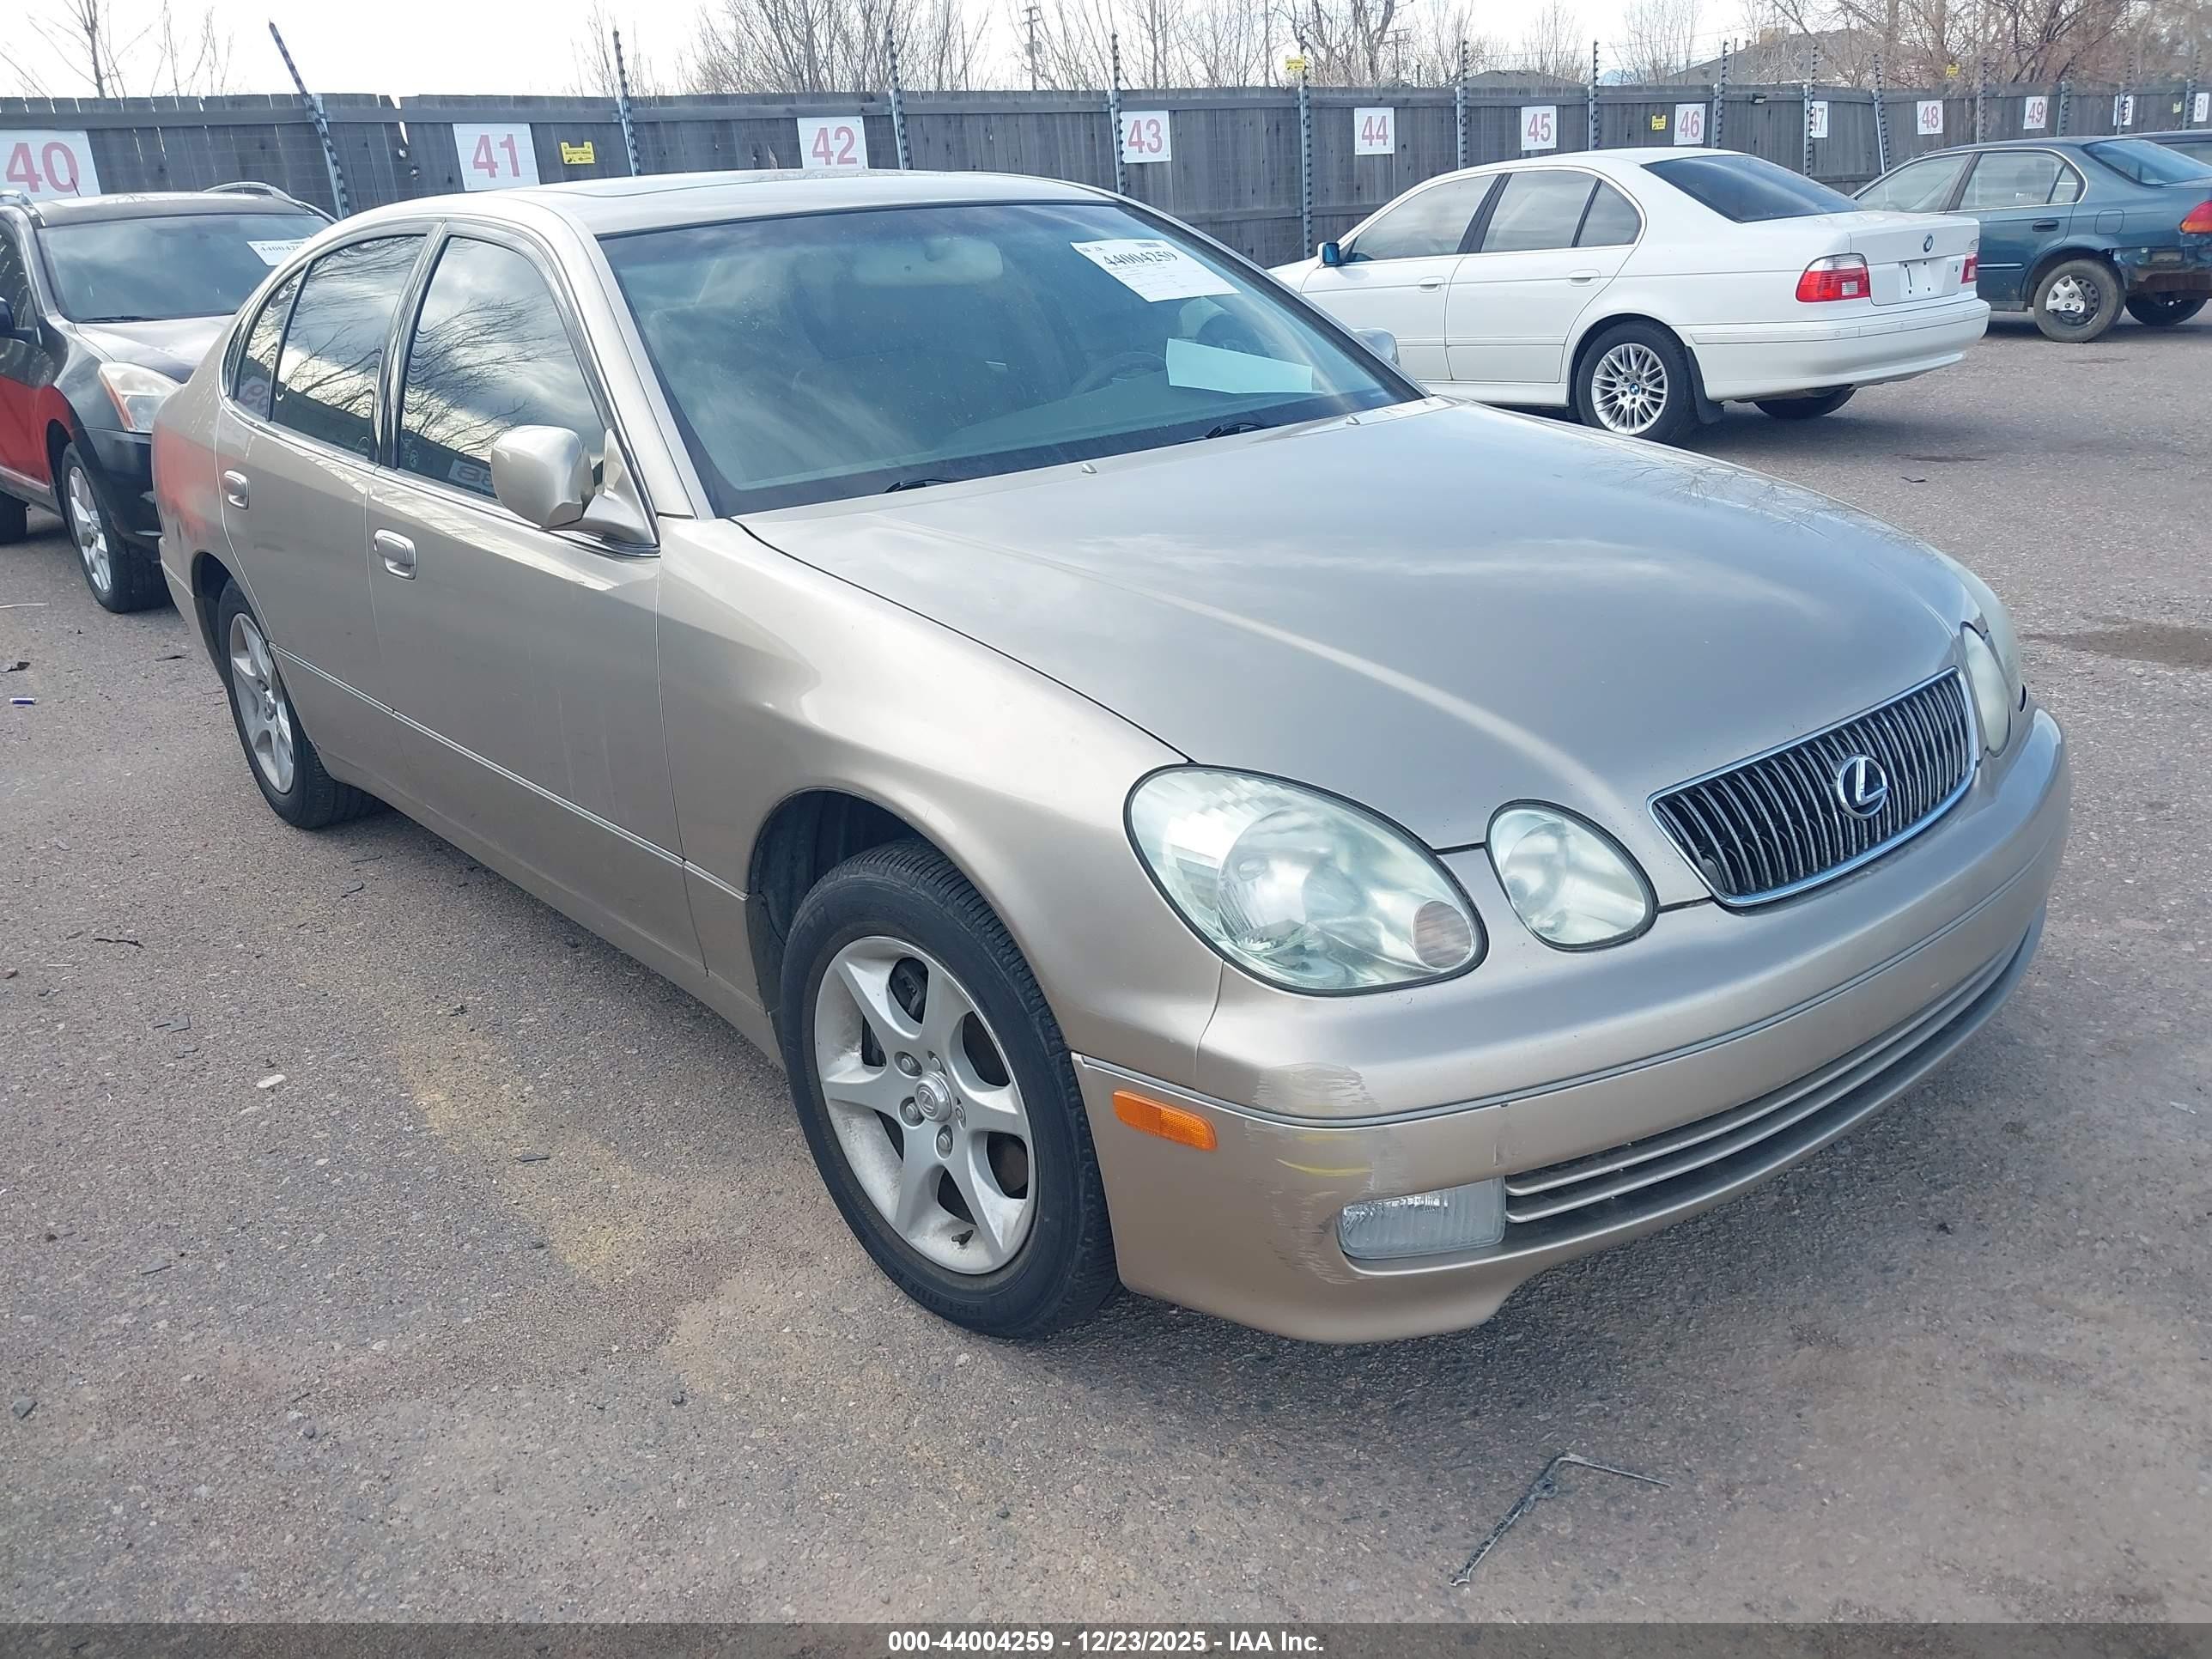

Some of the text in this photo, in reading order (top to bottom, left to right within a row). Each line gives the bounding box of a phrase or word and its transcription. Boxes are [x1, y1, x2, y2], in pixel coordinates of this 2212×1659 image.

[1528, 112, 1552, 143] 45
[1680, 110, 1700, 138] 46
[1922, 106, 1939, 129] 48
[2027, 101, 2044, 124] 49
[812, 126, 858, 166] 42
[1127, 118, 1163, 154] 43
[1361, 115, 1389, 147] 44
[6, 142, 79, 193] 40
[472, 133, 520, 179] 41
[1103, 251, 1178, 266] 44004259
